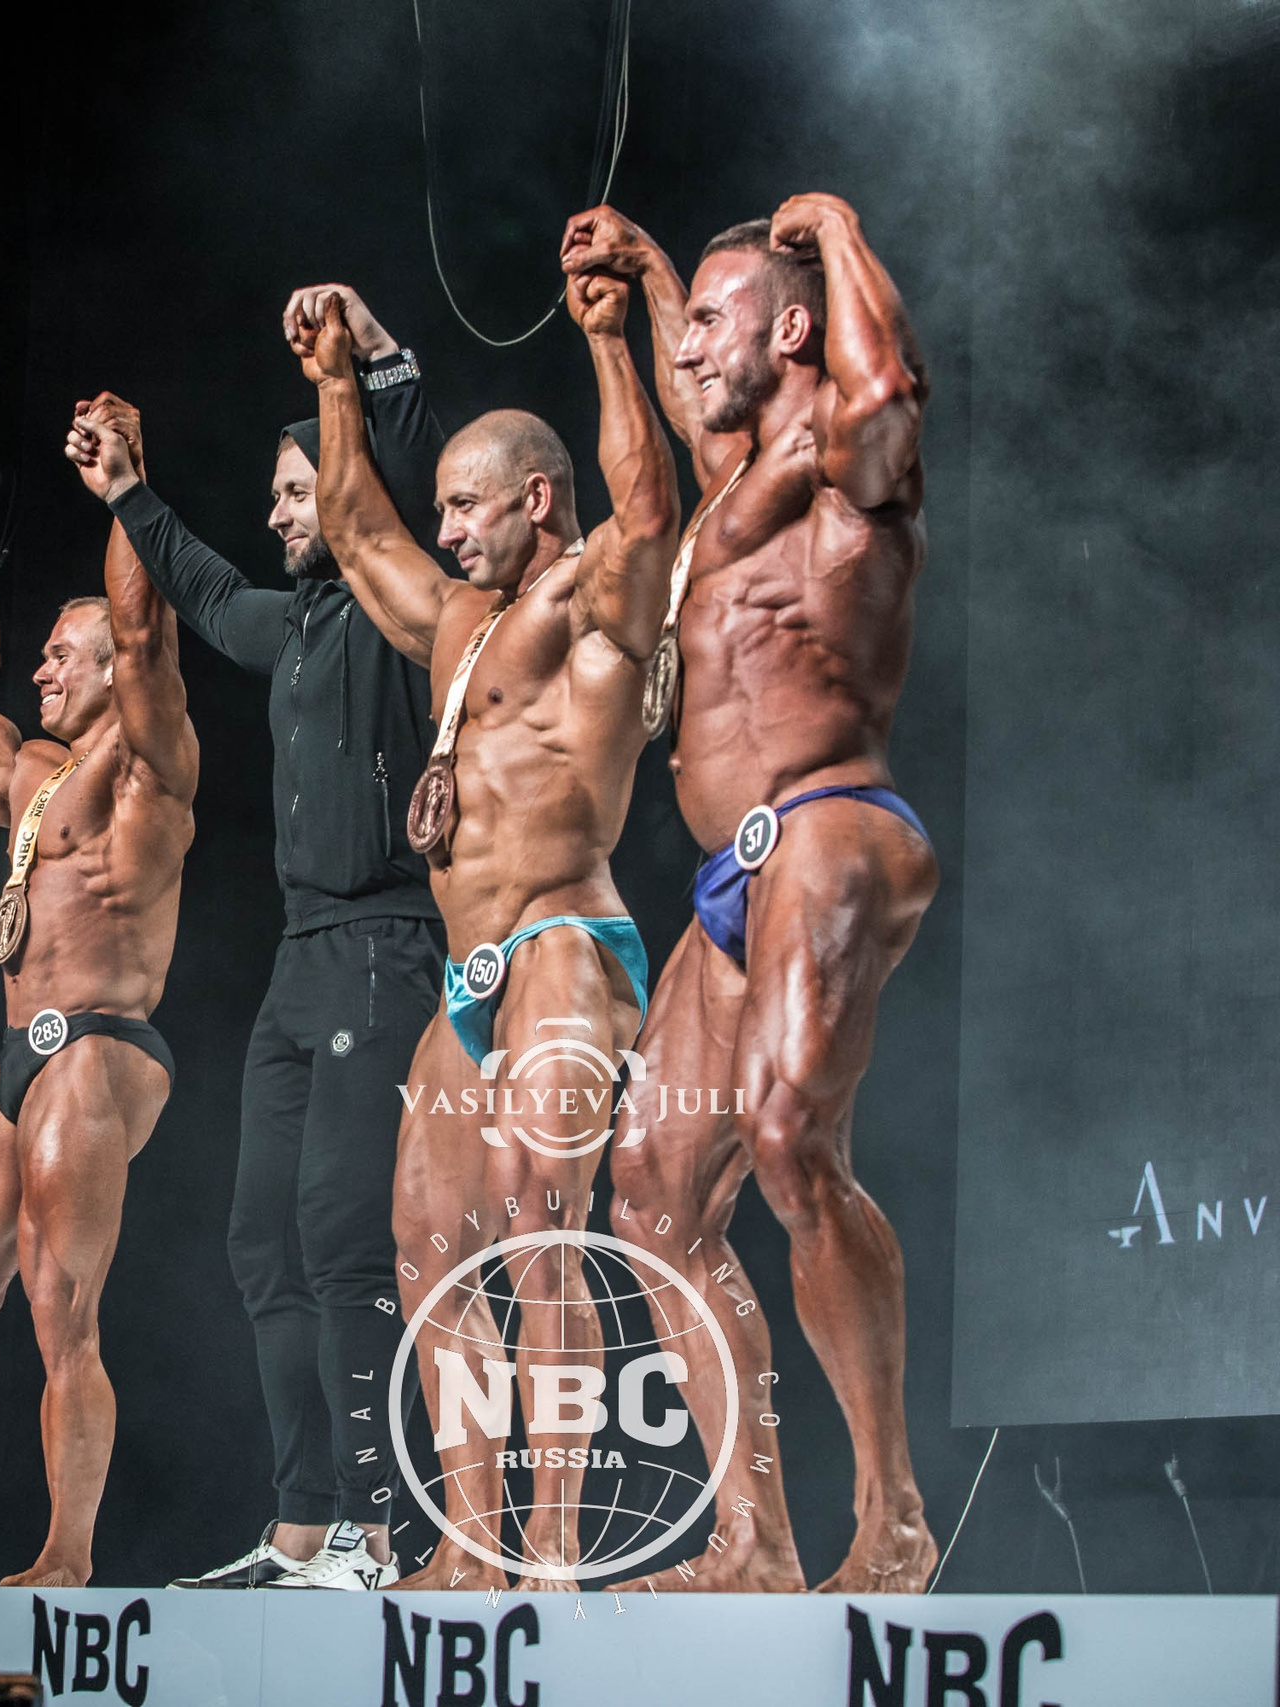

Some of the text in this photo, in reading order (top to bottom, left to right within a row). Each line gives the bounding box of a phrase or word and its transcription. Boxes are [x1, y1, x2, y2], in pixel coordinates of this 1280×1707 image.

[34, 797, 48, 817] NBC
[16, 831, 35, 867] NBC
[744, 819, 765, 854] 37
[470, 957, 497, 986] 150
[33, 1018, 62, 1046] 283
[31, 1592, 152, 1707] NBC
[380, 1596, 541, 1707] NBC
[846, 1603, 1063, 1707] NBC
